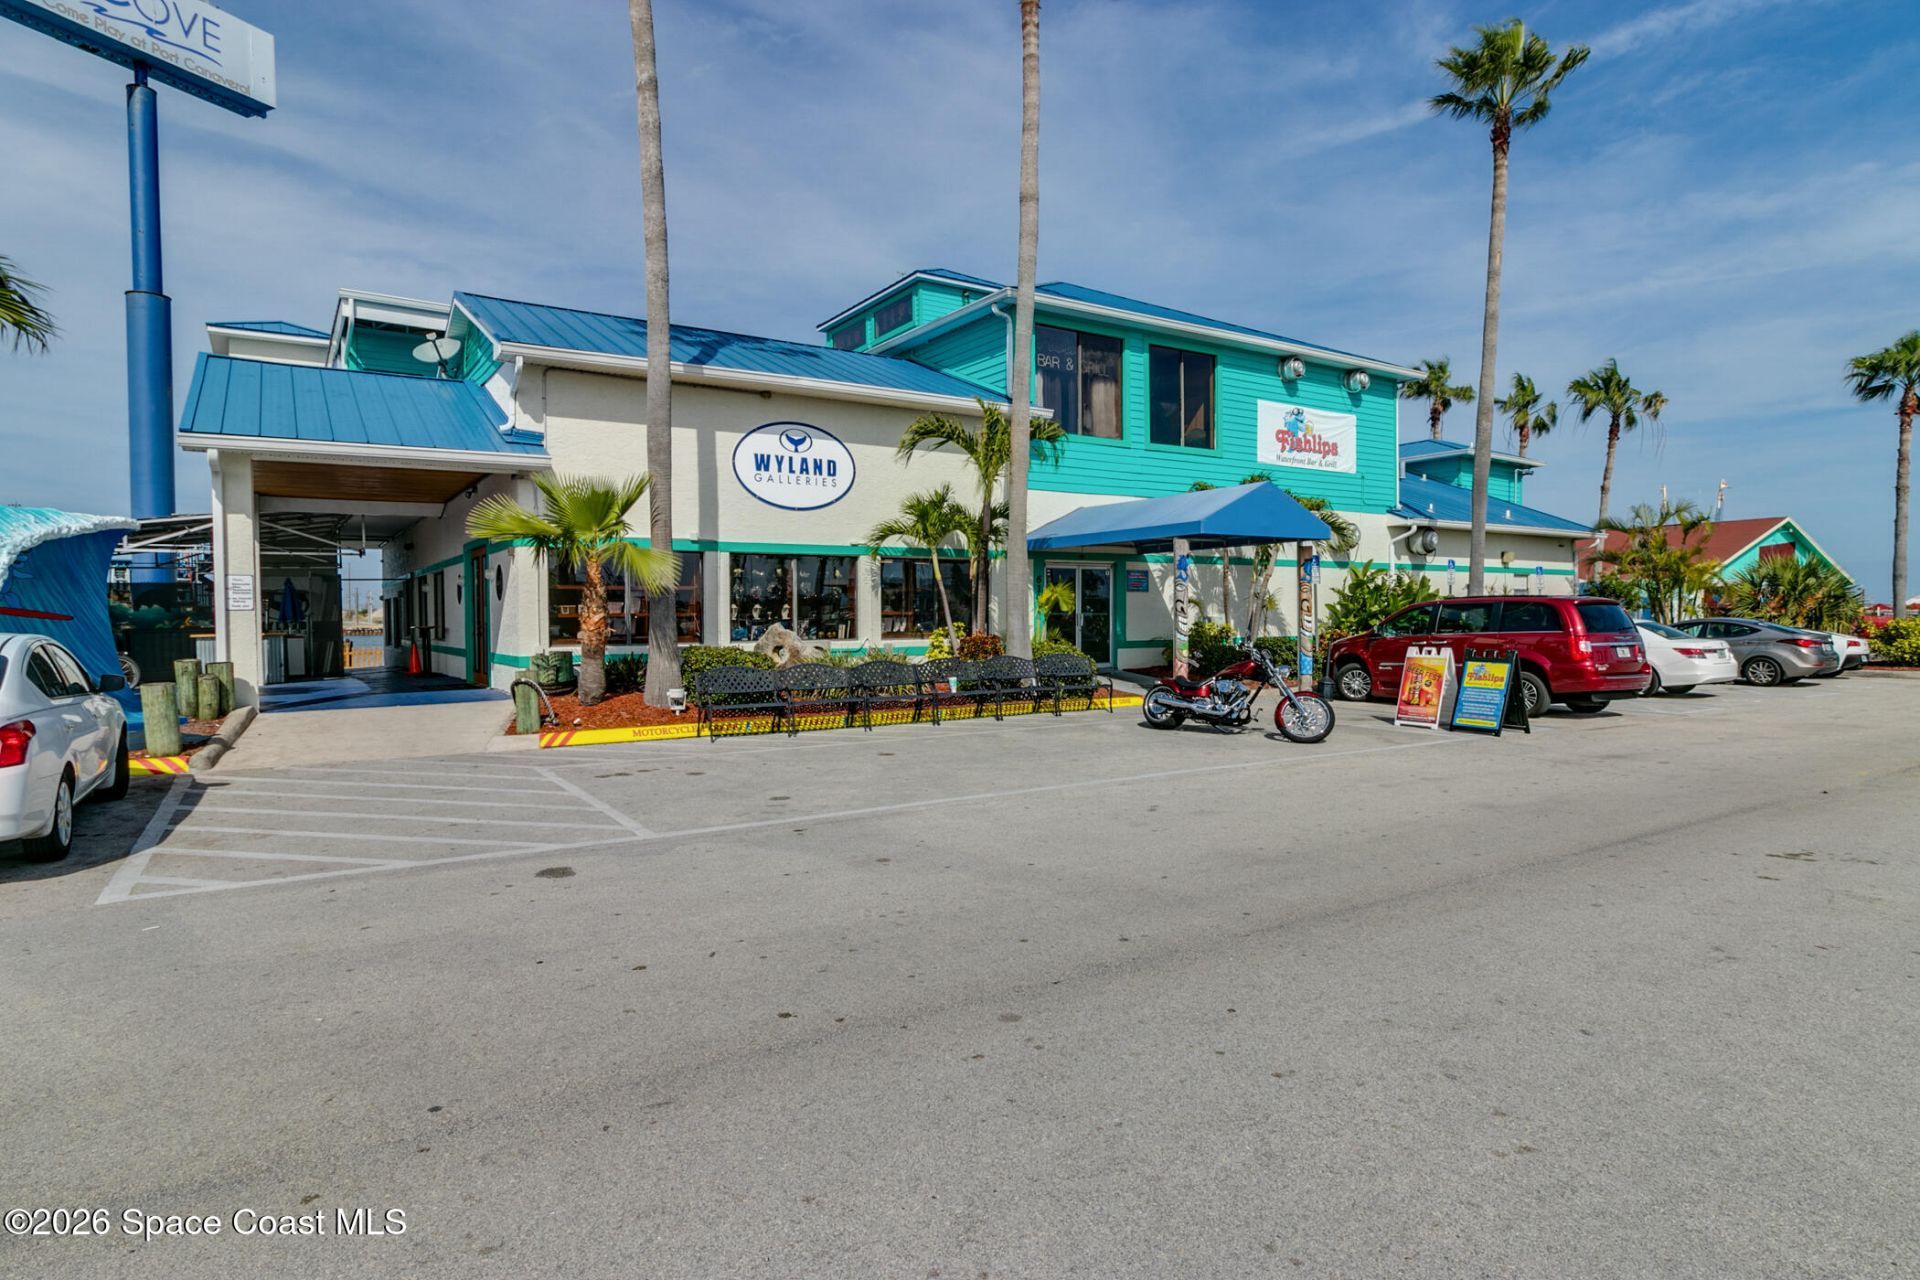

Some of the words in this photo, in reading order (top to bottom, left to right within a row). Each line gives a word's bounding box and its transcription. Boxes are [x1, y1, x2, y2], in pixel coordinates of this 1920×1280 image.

[106, 0, 221, 54] OVE
[95, 15, 126, 40] Play
[131, 36, 146, 51] at
[152, 41, 179, 63] Port
[184, 57, 251, 96] Canaveral
[1037, 353, 1060, 369] BAR
[1066, 357, 1074, 371] &
[1275, 429, 1339, 459] Fishlips
[754, 453, 837, 477] WYLAND
[754, 473, 837, 487] GALLERIES
[632, 725, 698, 737] MOTORCYCLE
